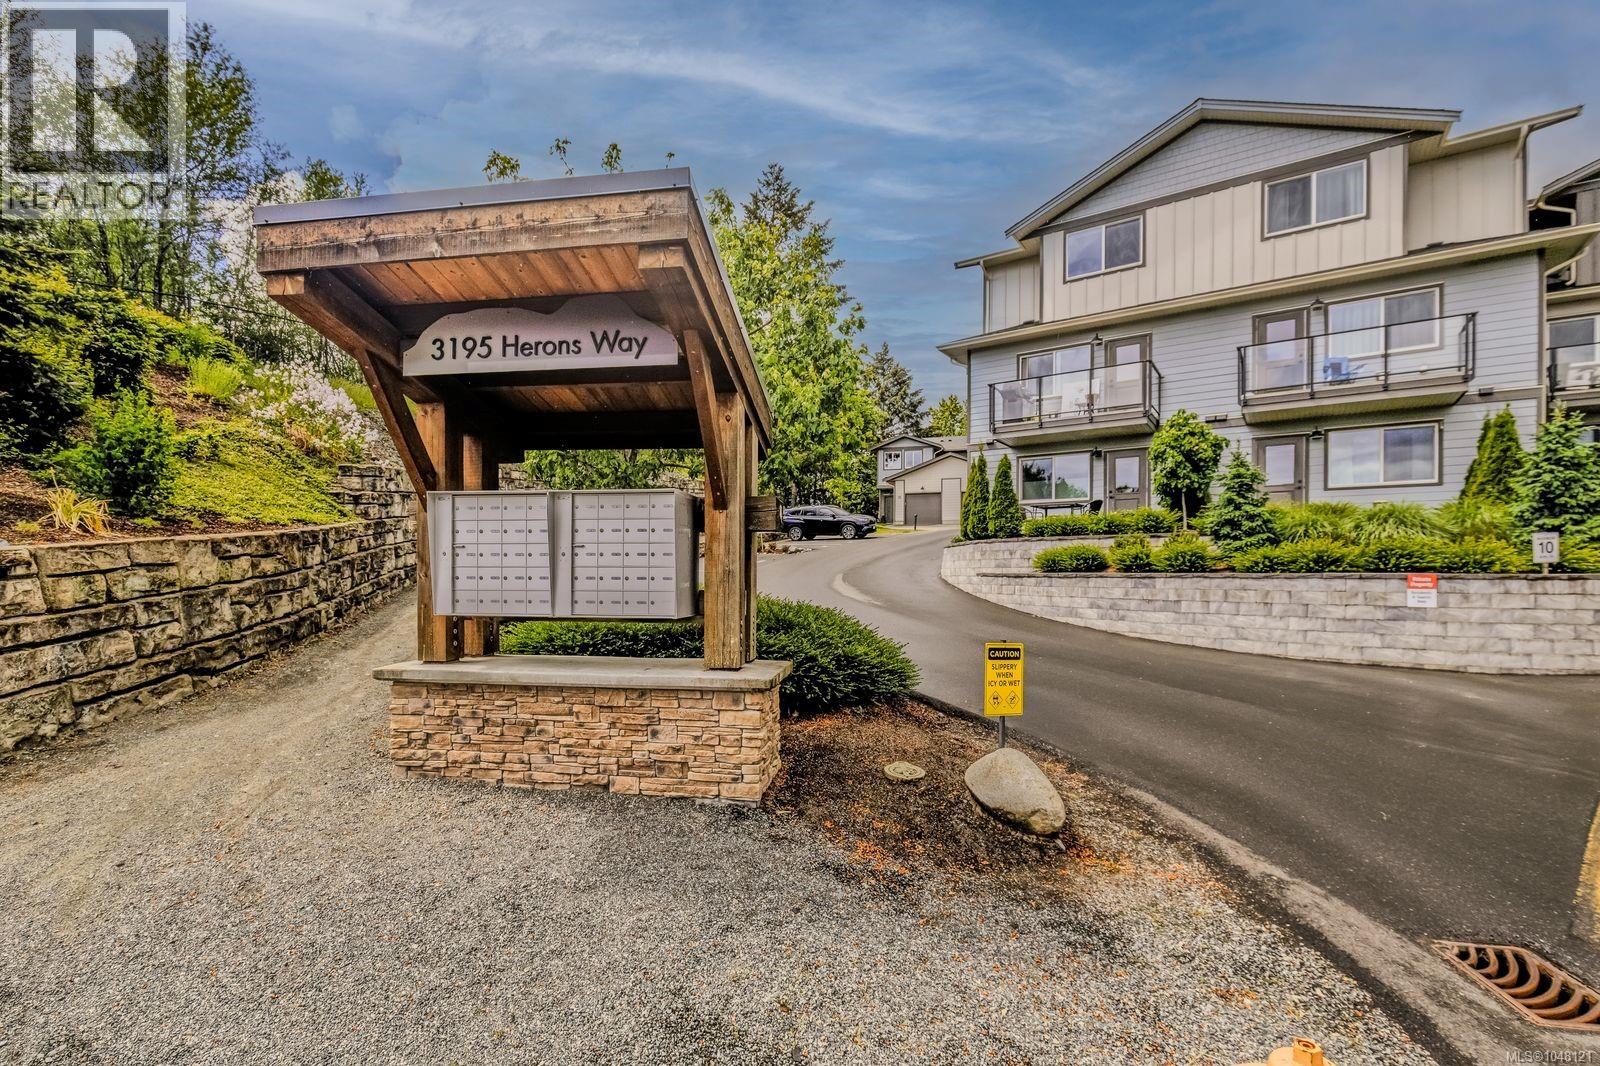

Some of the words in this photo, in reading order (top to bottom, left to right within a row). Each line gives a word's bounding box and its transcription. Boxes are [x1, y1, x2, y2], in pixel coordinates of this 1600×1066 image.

[430, 335, 492, 361] 3195
[501, 334, 582, 358] Herons
[590, 329, 648, 360] Way
[1538, 541, 1554, 554] 10
